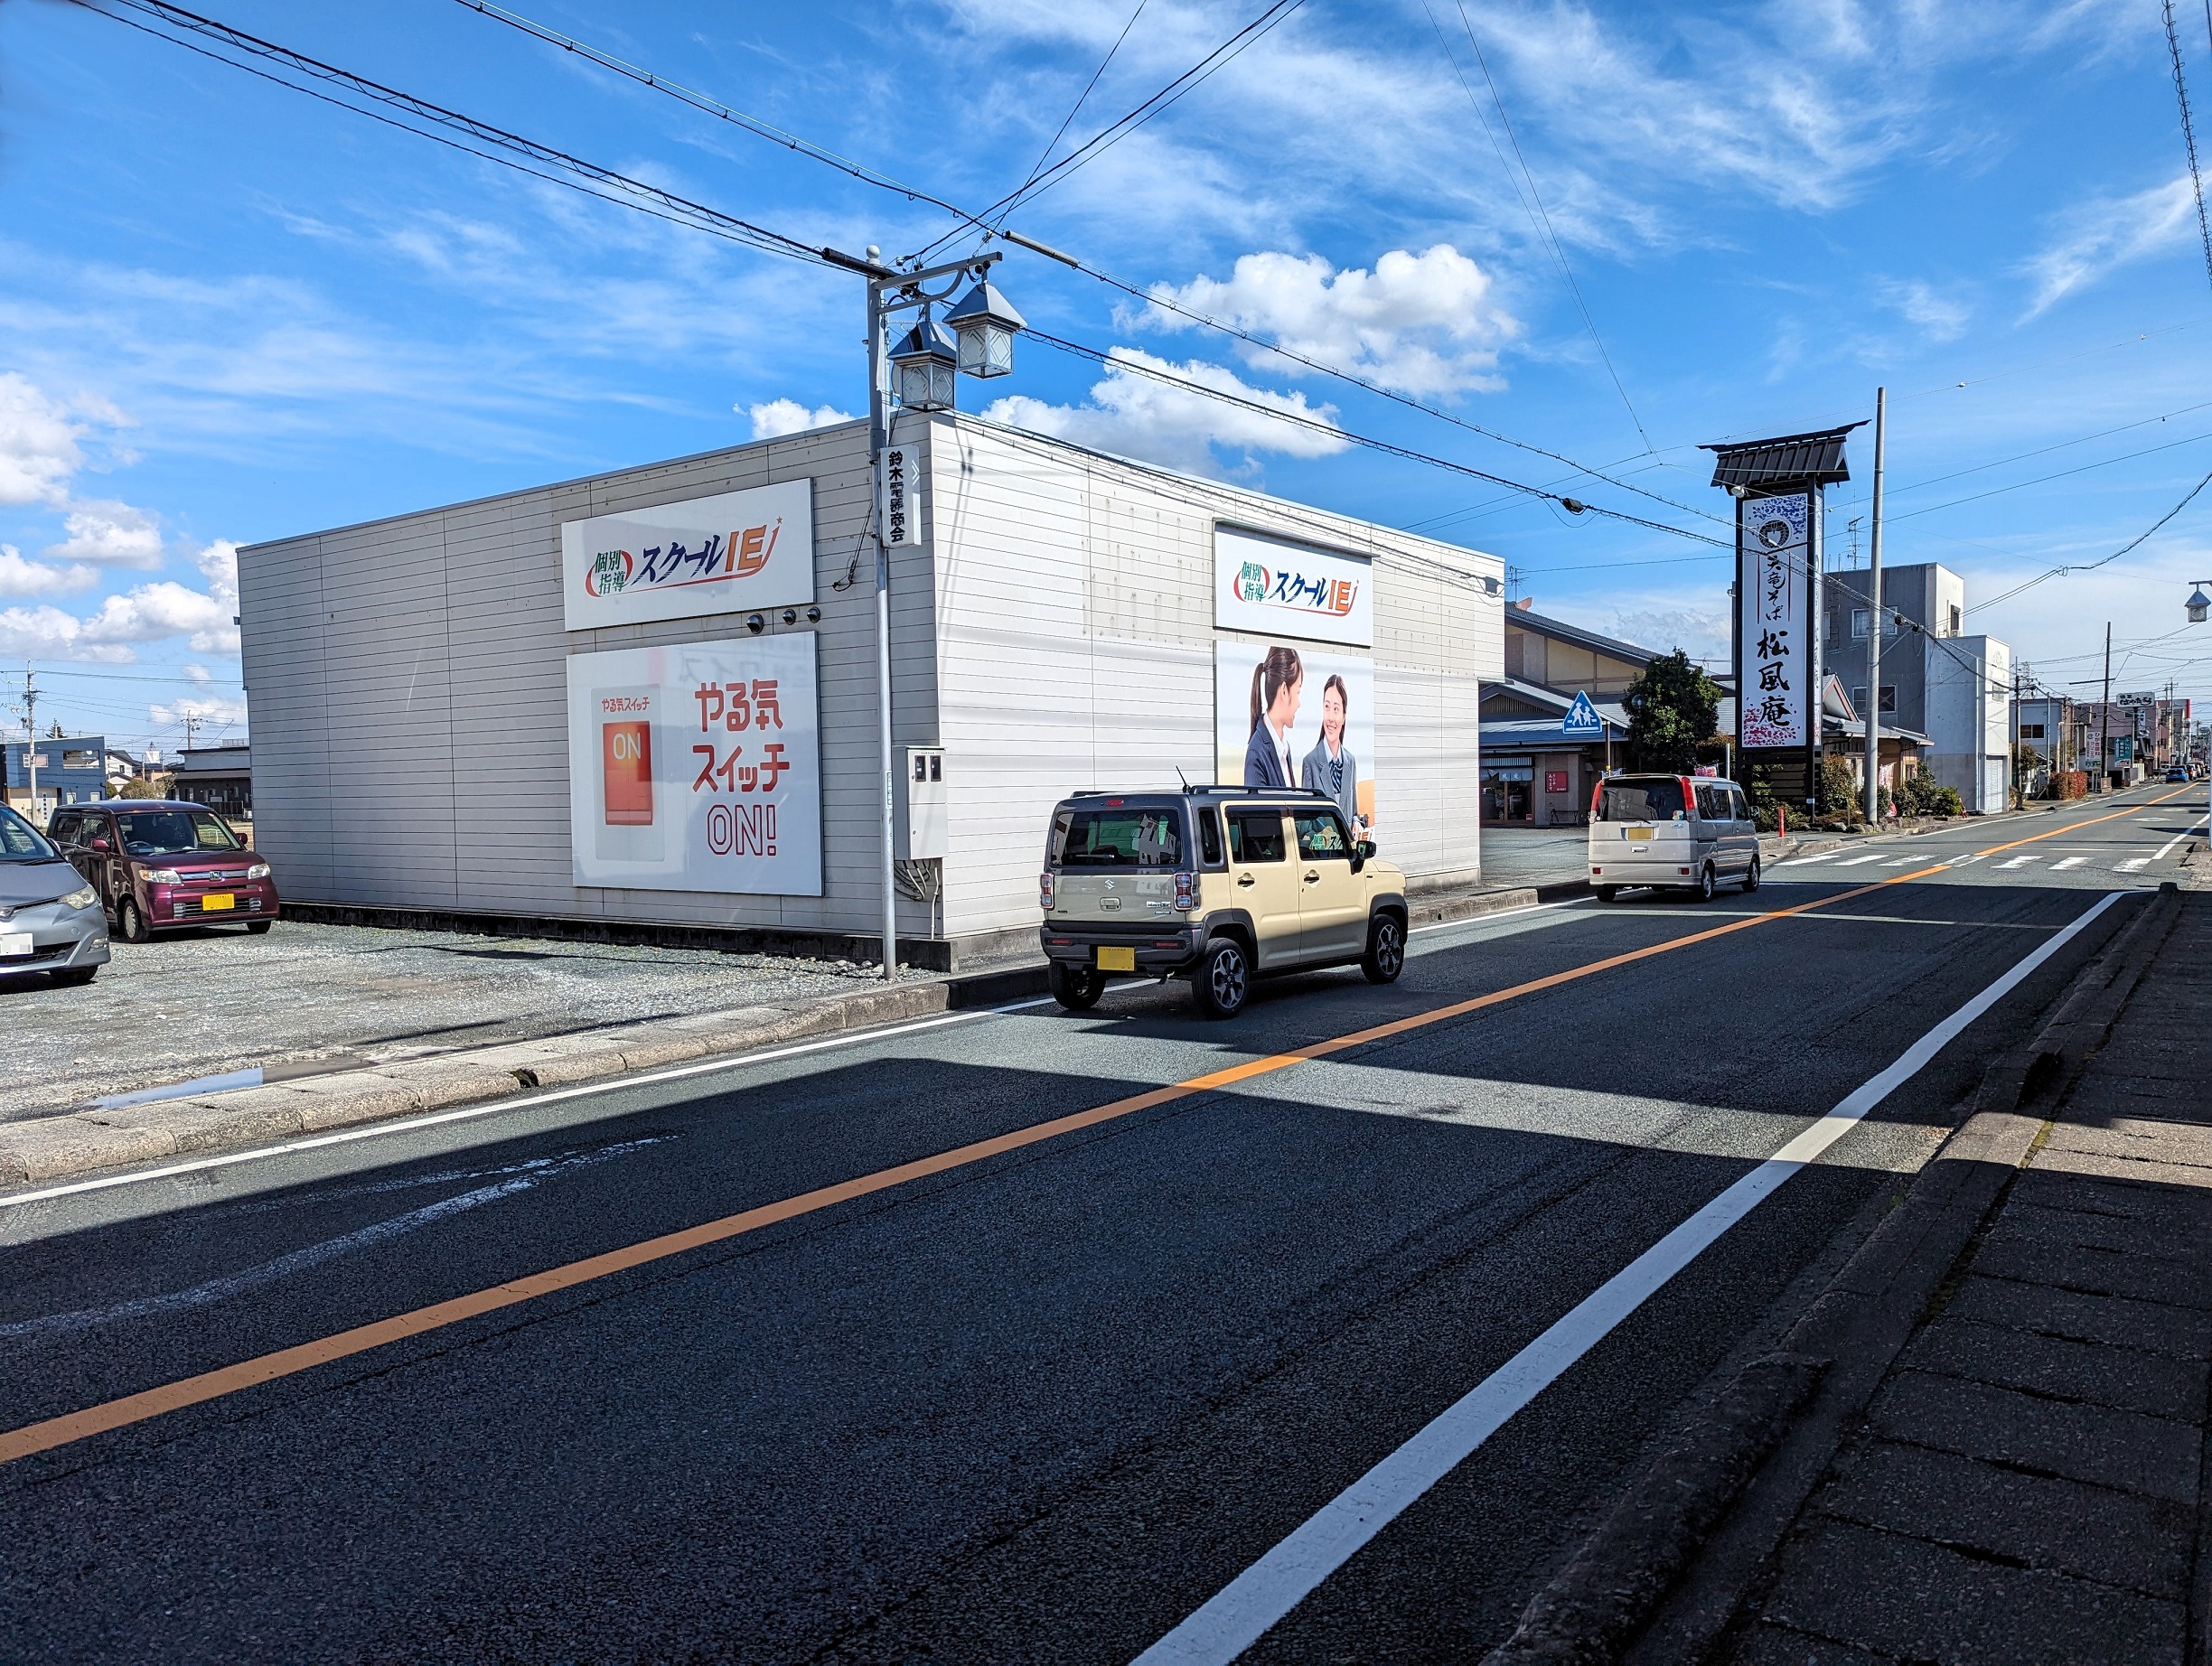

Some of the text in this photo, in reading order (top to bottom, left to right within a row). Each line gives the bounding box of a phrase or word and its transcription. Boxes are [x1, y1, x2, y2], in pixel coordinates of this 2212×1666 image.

[595, 549, 623, 574] 個別
[1242, 561, 1262, 582] 個別
[598, 570, 630, 595] 指導
[1244, 581, 1267, 603] 指導
[1757, 628, 1791, 726] 松風庵
[602, 696, 651, 713] やる気スイッチ
[694, 679, 784, 732] やる気
[613, 732, 642, 761] ON
[692, 744, 790, 793] スイッチ
[708, 804, 776, 856] ON!
